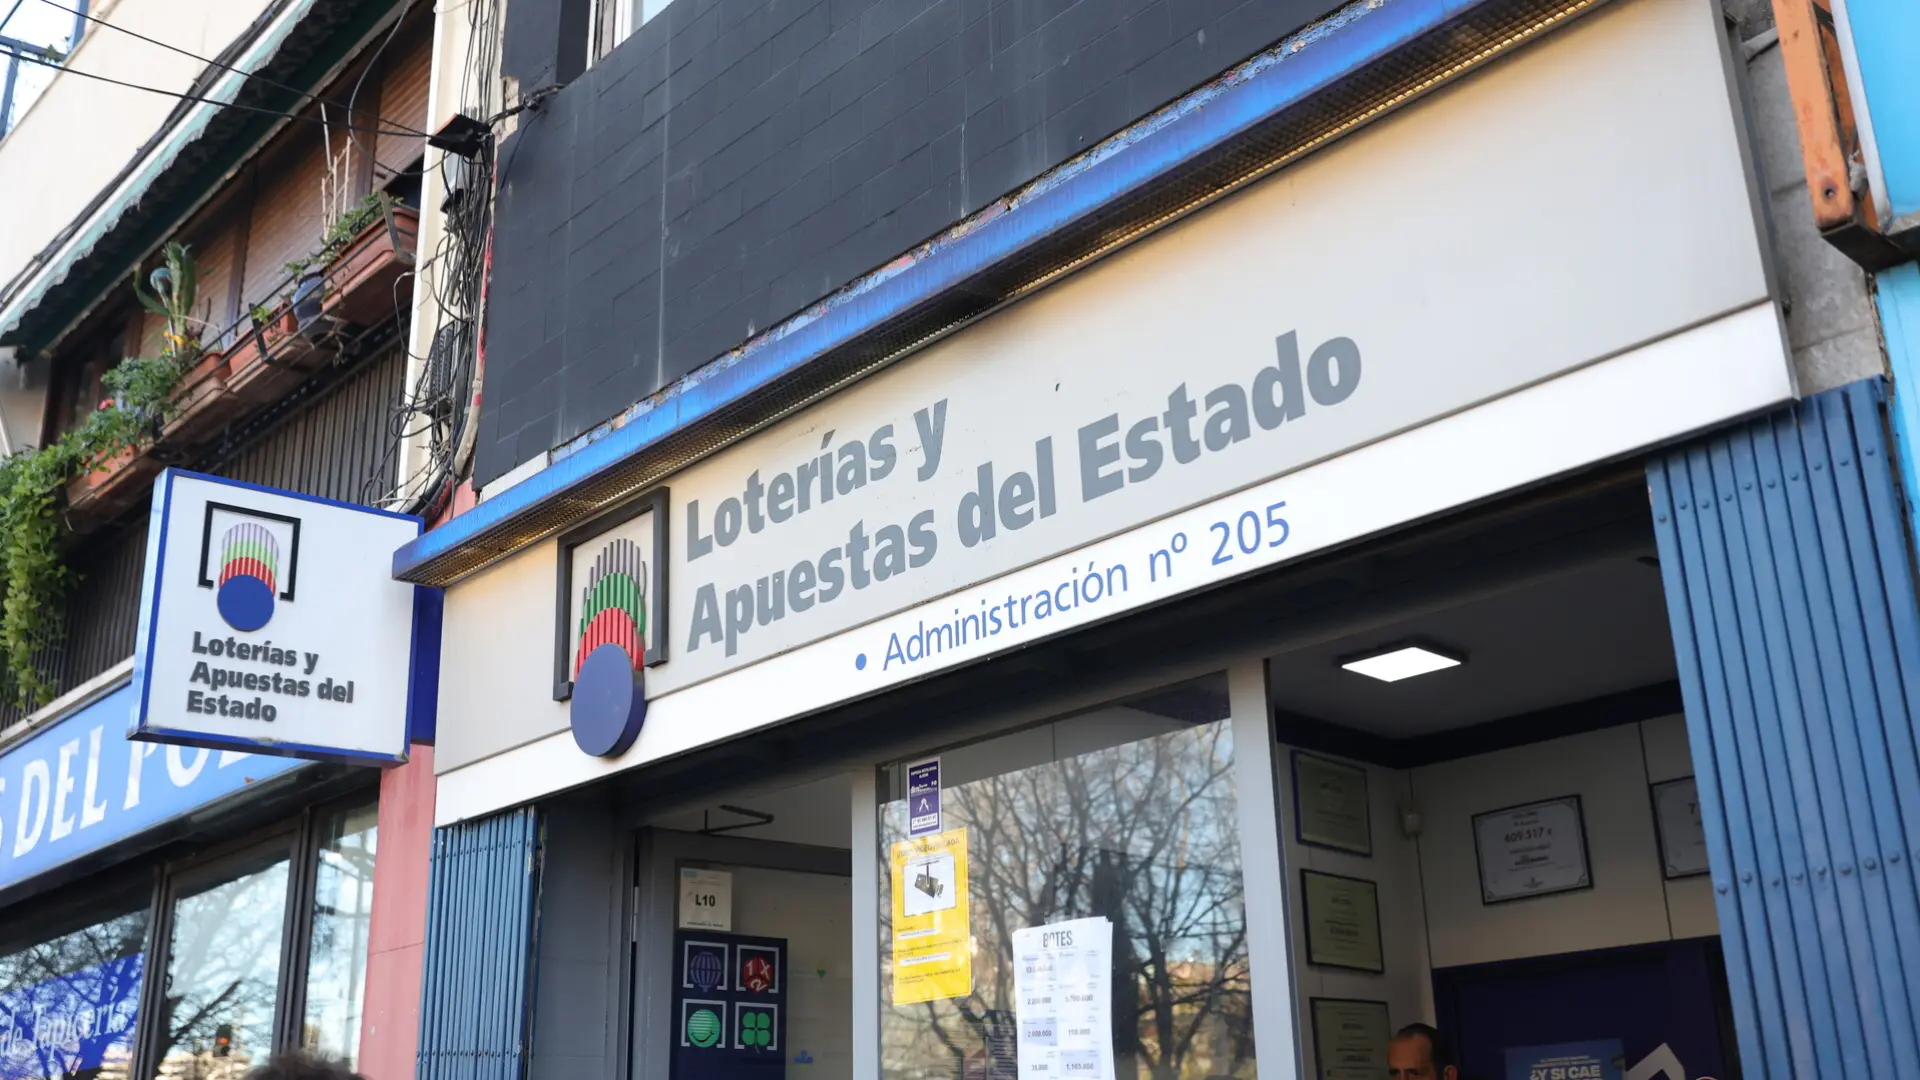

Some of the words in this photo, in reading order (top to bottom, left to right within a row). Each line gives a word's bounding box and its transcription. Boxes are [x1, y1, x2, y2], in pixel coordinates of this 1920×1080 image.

[686, 429, 897, 562] Loterías
[917, 398, 949, 482] y
[686, 508, 938, 658] Apuestas
[956, 435, 1058, 550] del
[1078, 329, 1363, 503] Estado
[882, 561, 1129, 671] Administración
[1210, 500, 1291, 566] 205
[191, 630, 298, 667] Loterías
[303, 651, 319, 676] y
[189, 660, 311, 697] Apuestas
[317, 676, 354, 703] del
[186, 689, 277, 722] Estado
[13, 725, 107, 859] DEL
[695, 893, 716, 908] L10
[1550, 1066, 1566, 1080] SI
[1568, 1065, 1601, 1079] CAE
